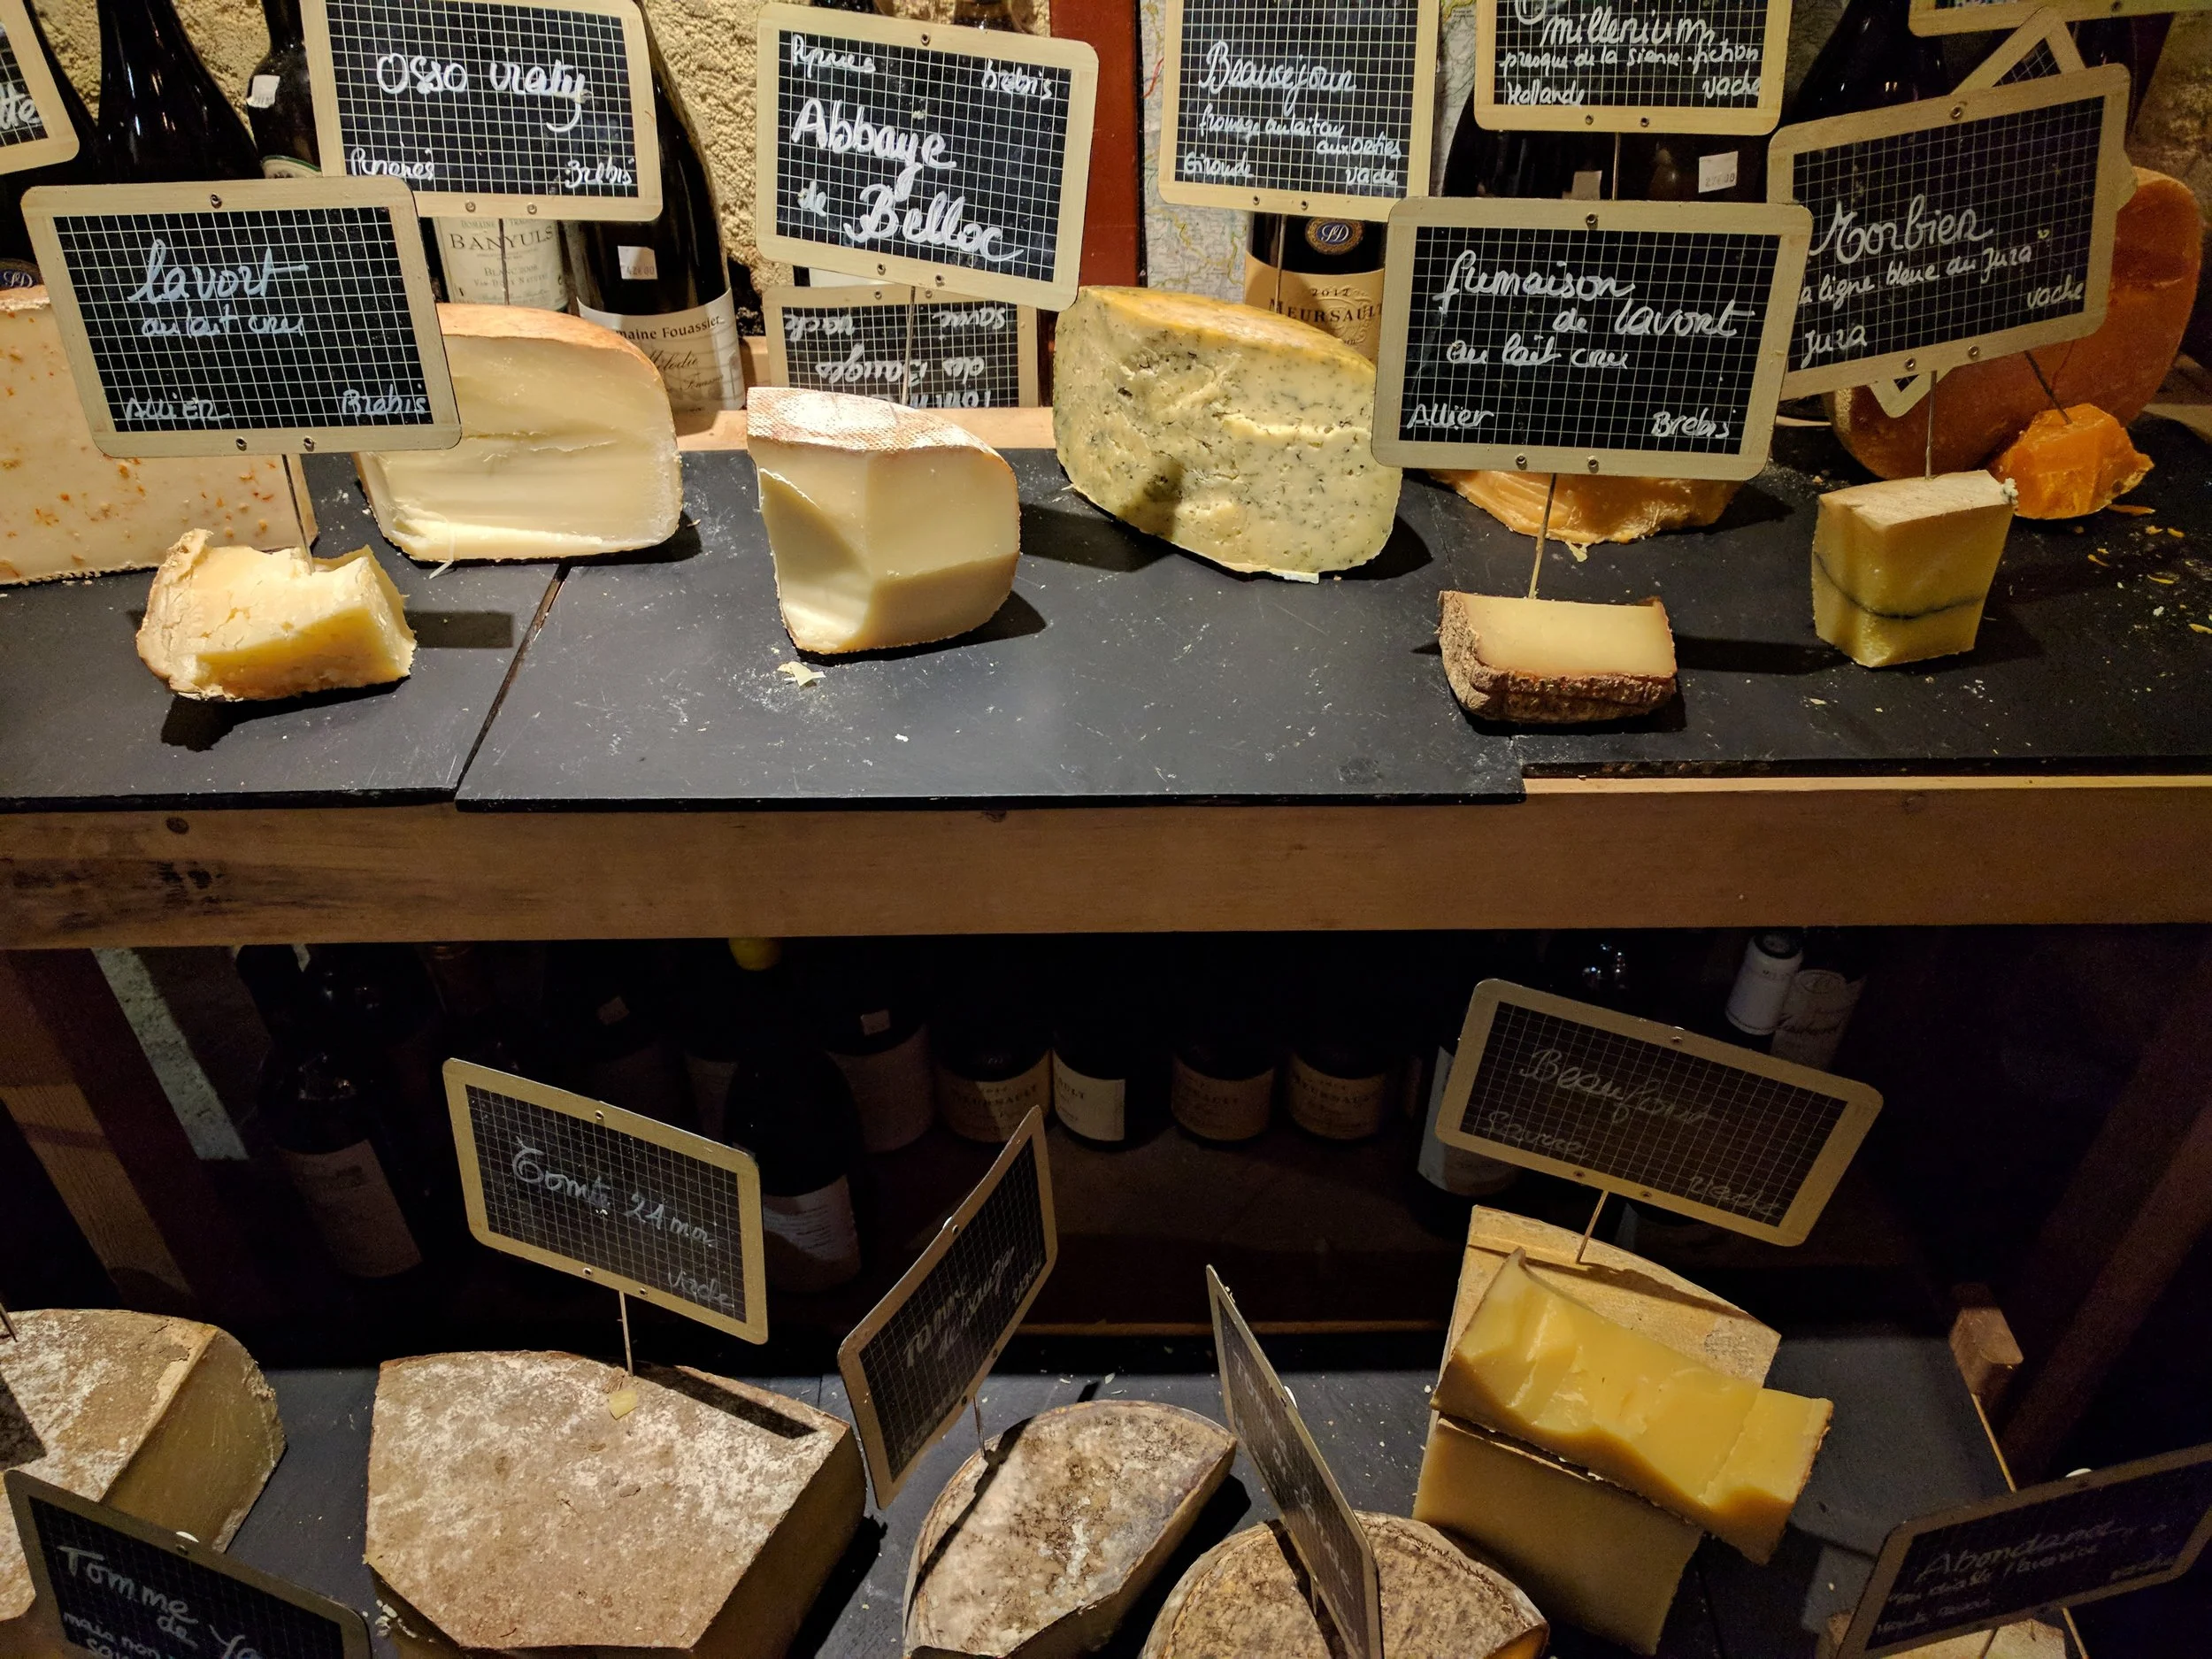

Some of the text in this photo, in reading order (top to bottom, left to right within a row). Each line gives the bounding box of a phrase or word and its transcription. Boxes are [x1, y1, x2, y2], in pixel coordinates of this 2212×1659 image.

[1600, 44, 1618, 64] la
[791, 97, 956, 202] Abbaye
[797, 180, 1025, 262] de Belloc
[449, 225, 555, 251] BANYULS
[1819, 273, 1876, 311] ligne
[1886, 260, 1940, 288] bleue
[2026, 274, 2085, 310] vache
[616, 314, 721, 340] maine Fouassier
[1553, 307, 1589, 334] de
[1446, 339, 1488, 365] au
[1502, 333, 1563, 366] lait
